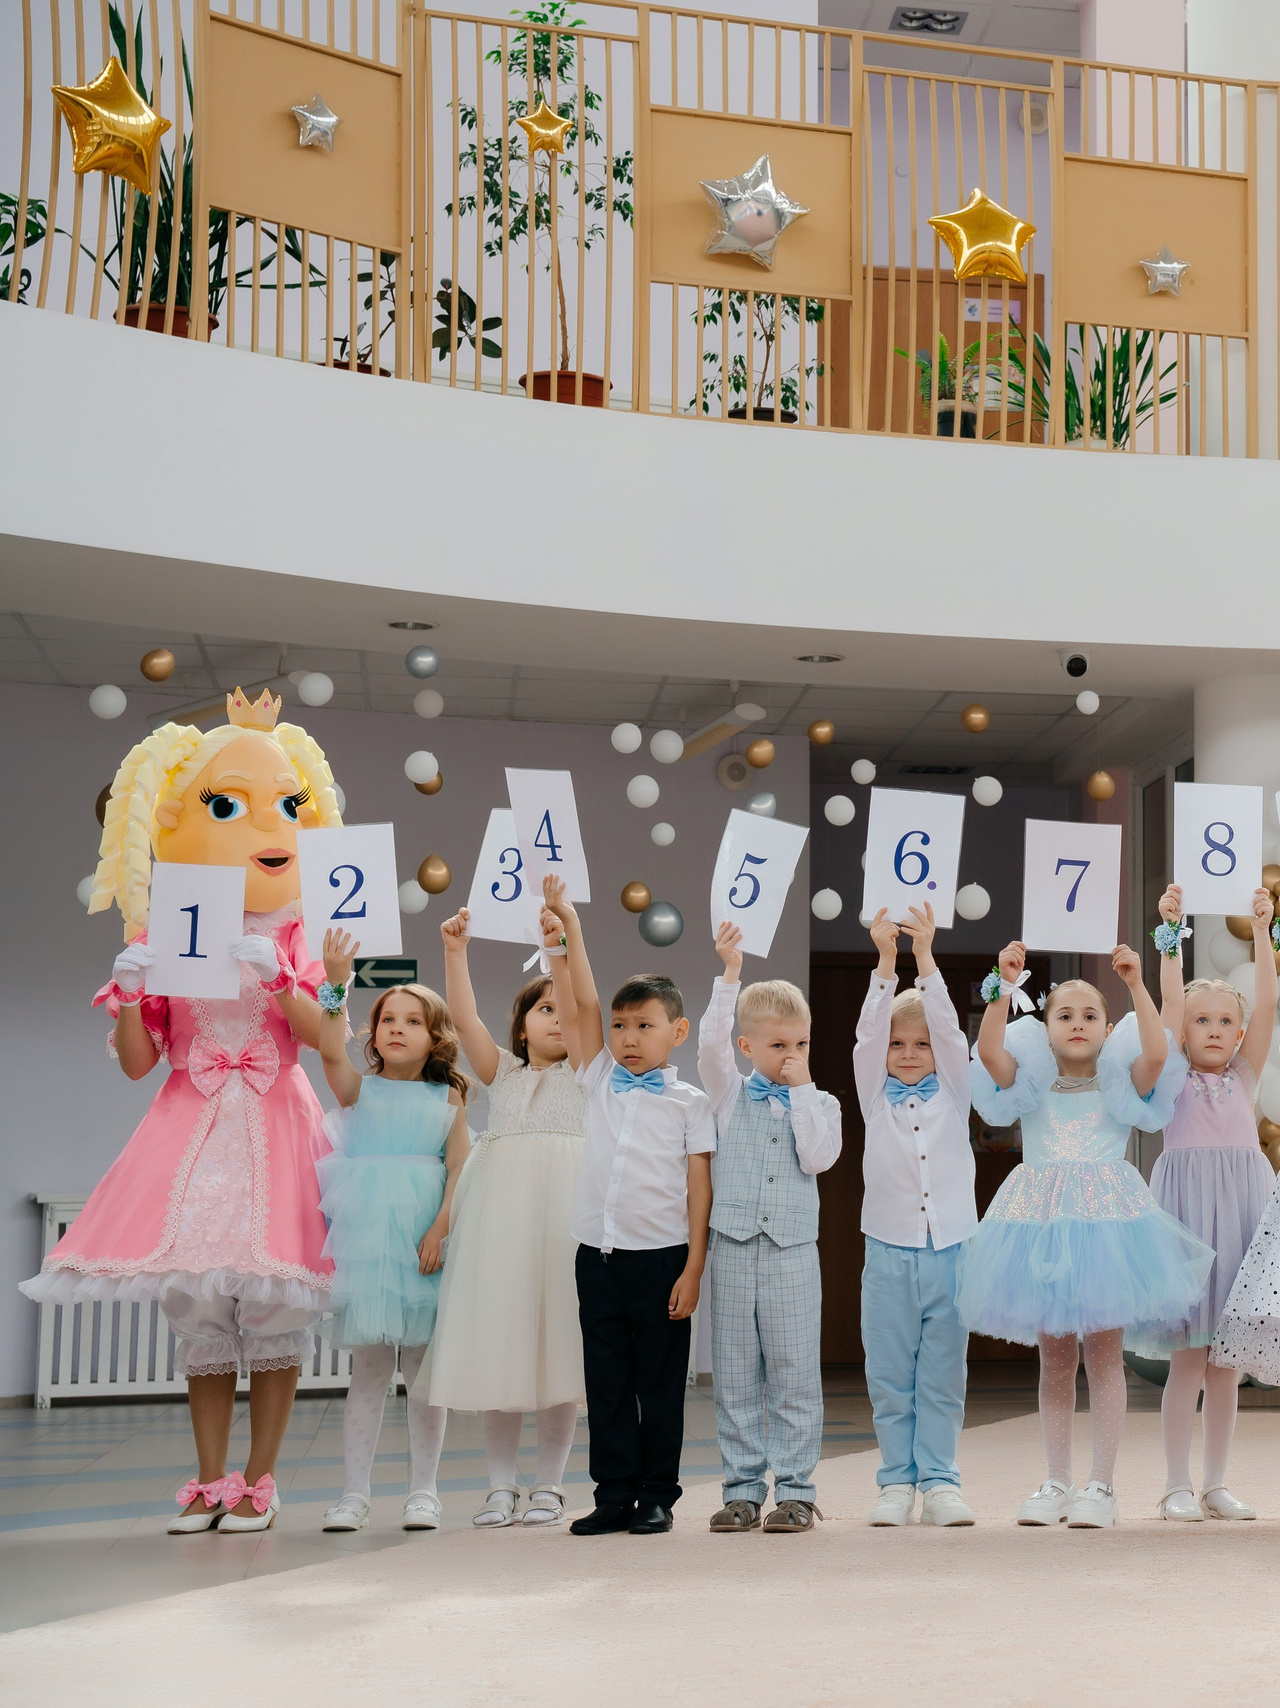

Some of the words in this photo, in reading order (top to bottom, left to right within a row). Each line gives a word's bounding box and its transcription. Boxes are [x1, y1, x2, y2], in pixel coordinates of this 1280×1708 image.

[533, 809, 563, 863] 4
[1201, 821, 1237, 877] 8
[328, 864, 367, 921] 2
[490, 847, 524, 903] 3
[728, 852, 768, 909] 5
[1055, 858, 1091, 913] 7
[178, 903, 208, 959] 1
